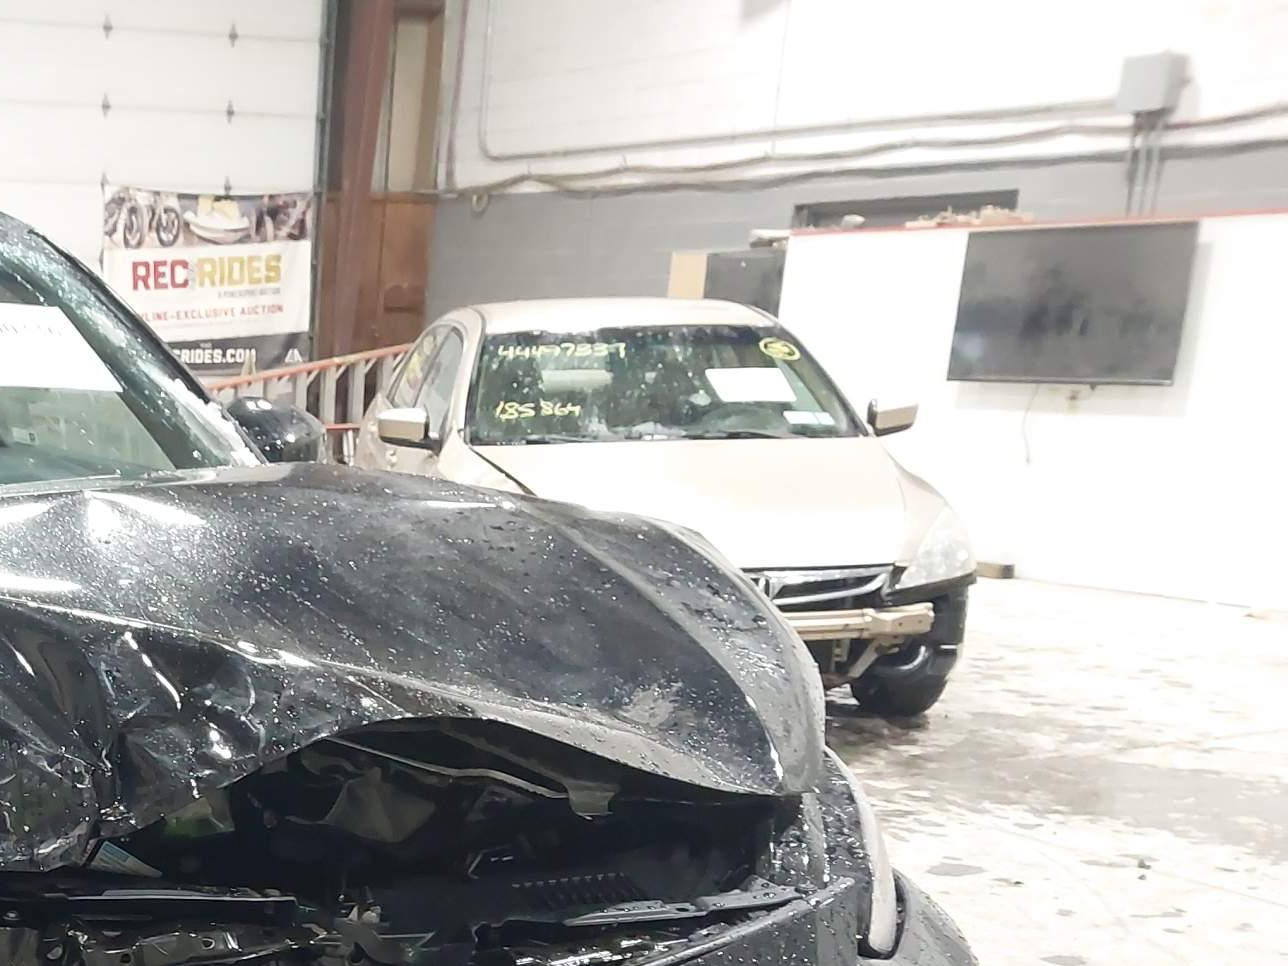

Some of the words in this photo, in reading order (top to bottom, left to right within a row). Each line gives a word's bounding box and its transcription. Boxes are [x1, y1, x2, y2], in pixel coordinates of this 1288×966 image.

[132, 260, 190, 290] REC
[197, 255, 281, 288] RIDES
[241, 304, 283, 316] AUCTION
